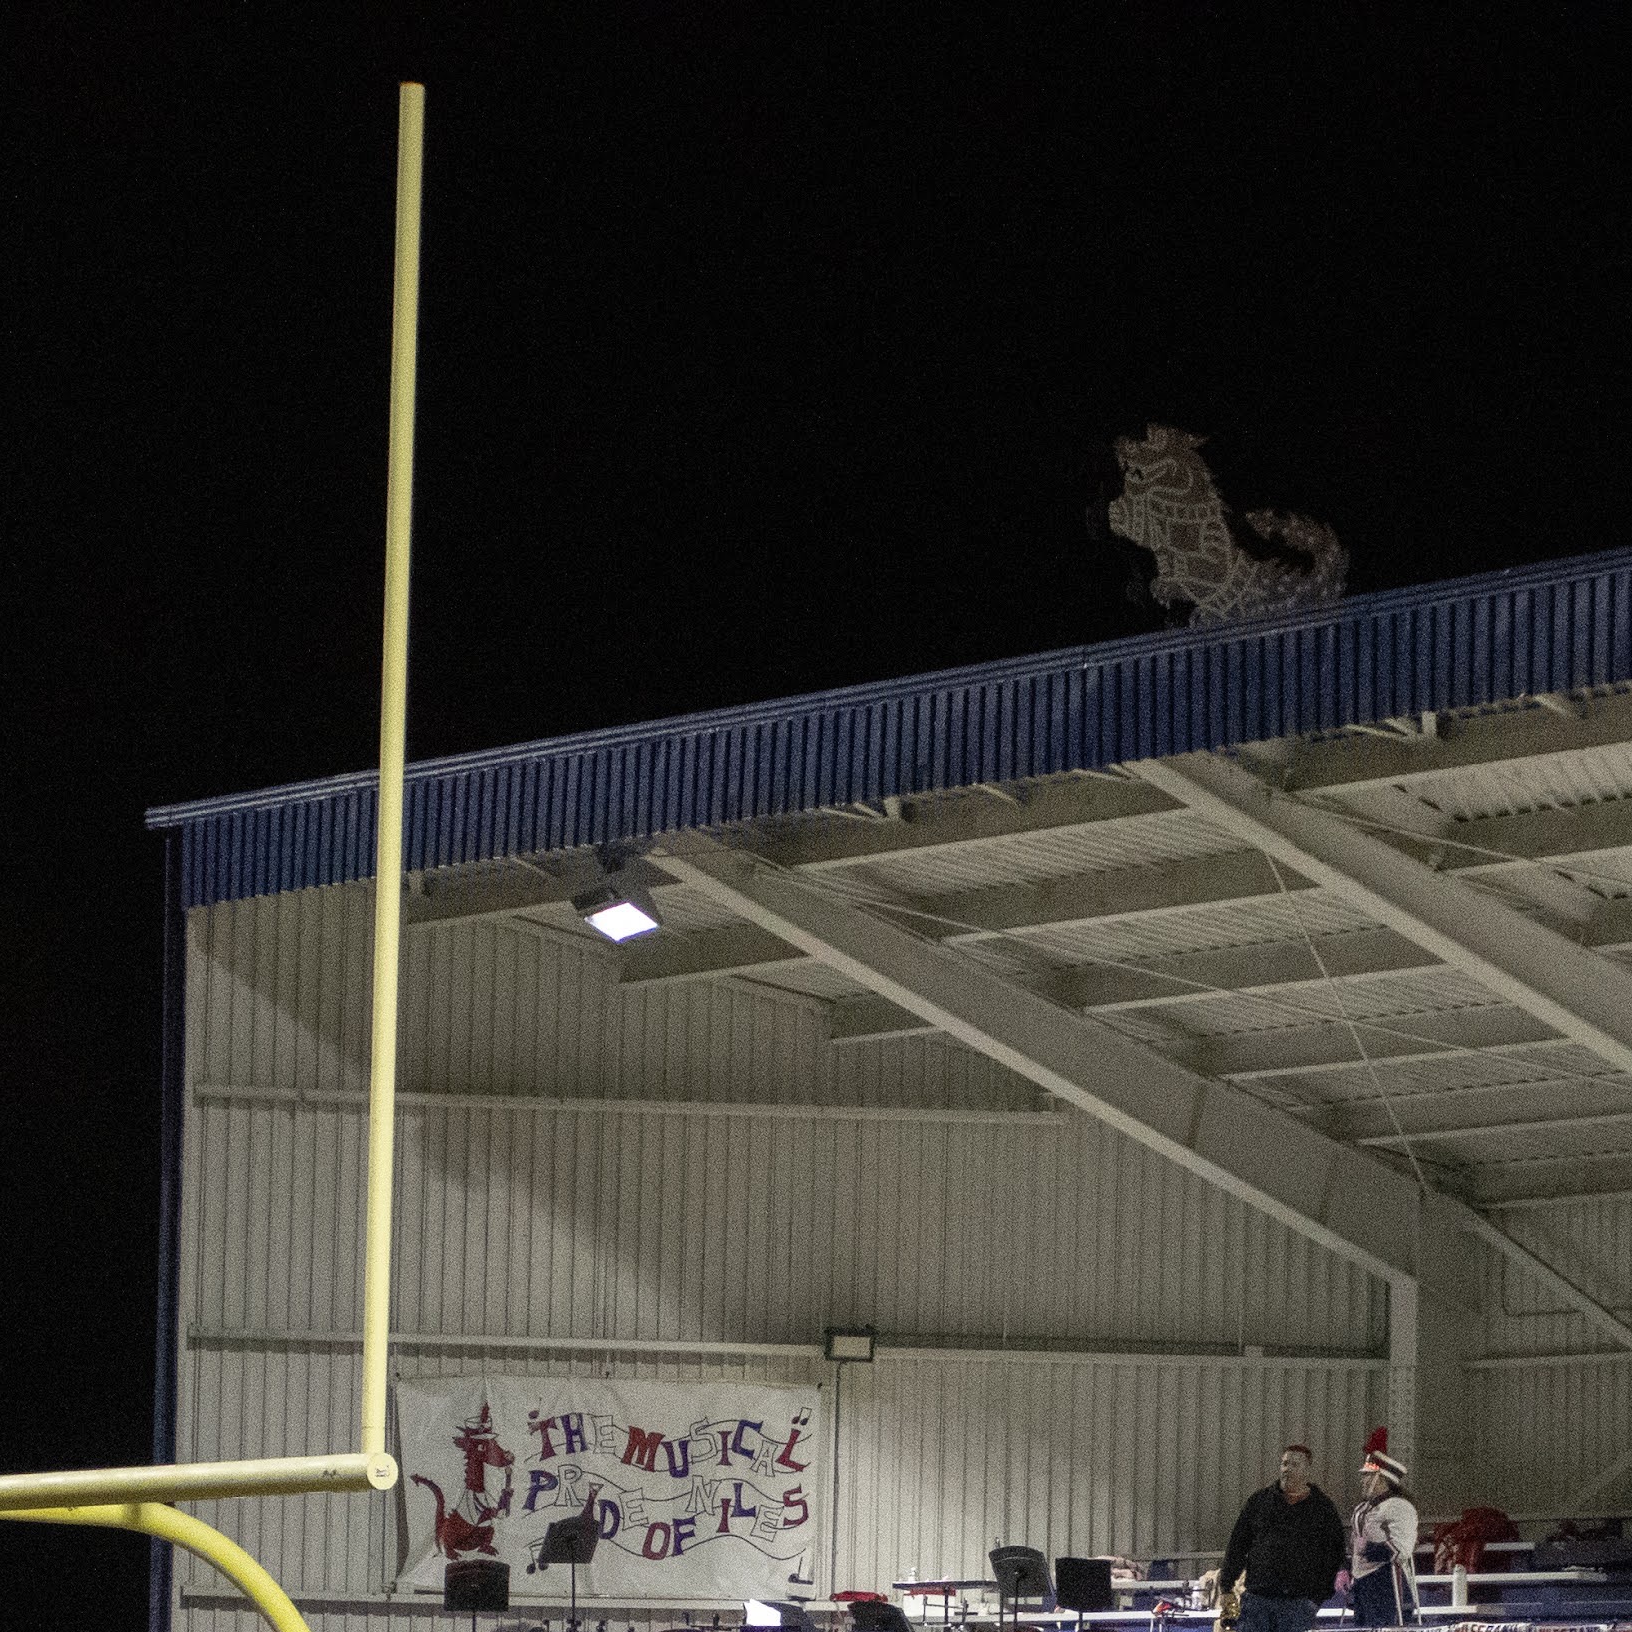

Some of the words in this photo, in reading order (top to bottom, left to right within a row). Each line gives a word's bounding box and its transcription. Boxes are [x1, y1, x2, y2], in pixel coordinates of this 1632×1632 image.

[529, 1412, 617, 1461] THE
[621, 1417, 811, 1478] MUSICAL
[522, 1464, 650, 1540] PRIDE
[642, 1516, 698, 1560] OF
[685, 1475, 810, 1542] NILES
